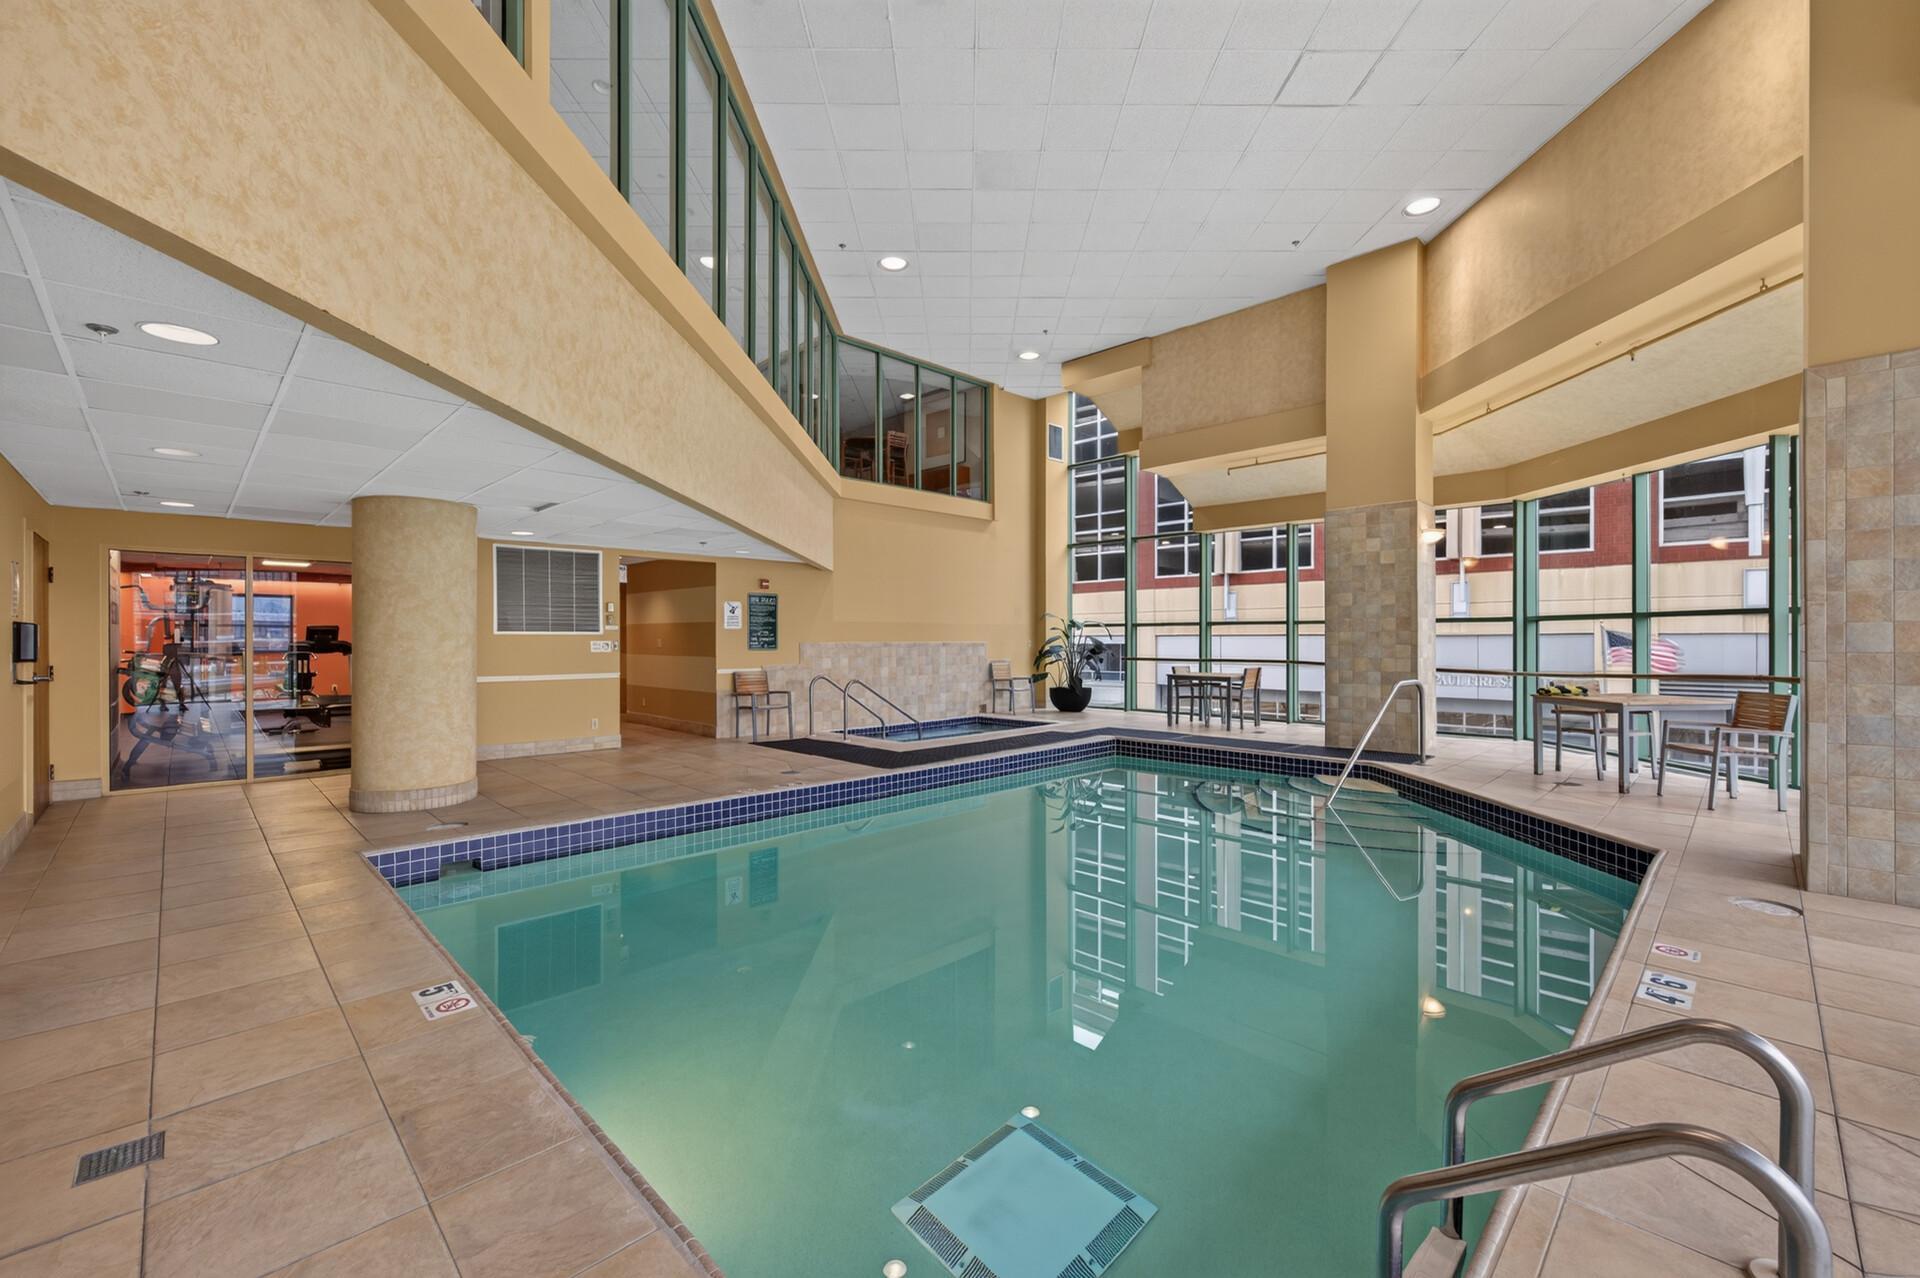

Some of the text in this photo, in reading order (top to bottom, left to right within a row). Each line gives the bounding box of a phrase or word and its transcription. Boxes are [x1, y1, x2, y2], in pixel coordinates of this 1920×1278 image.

[419, 983, 455, 997] 5
[1645, 977, 1688, 1004] 4 6
